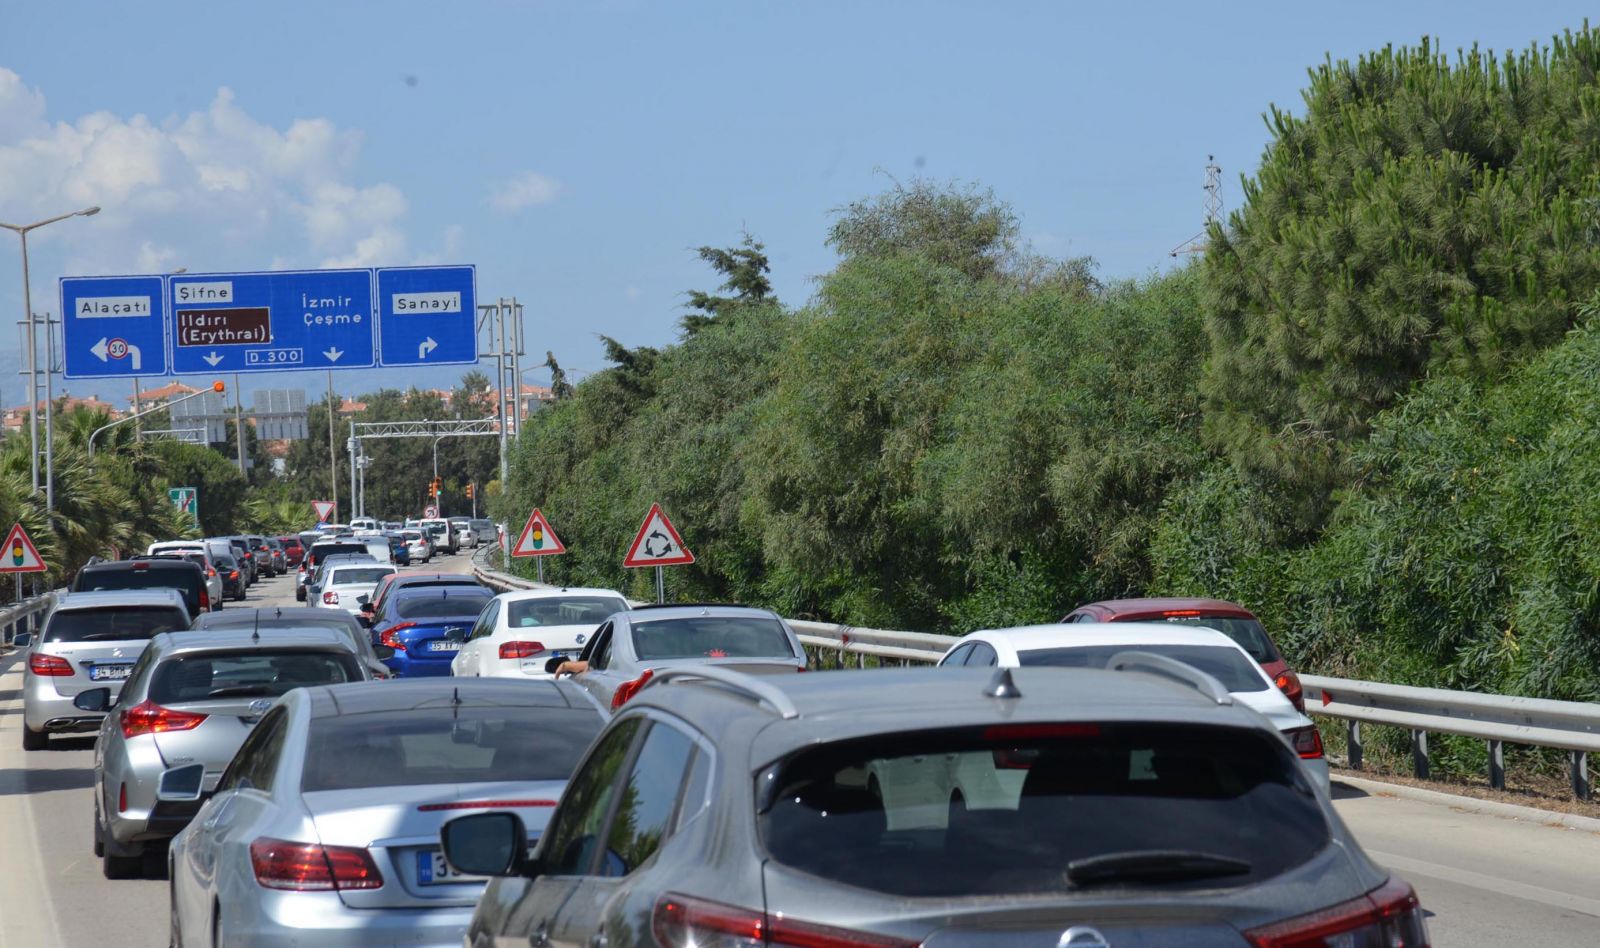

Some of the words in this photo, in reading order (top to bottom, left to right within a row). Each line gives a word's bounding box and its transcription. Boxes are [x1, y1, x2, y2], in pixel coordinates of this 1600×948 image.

[180, 287, 228, 300] Şifne
[302, 293, 352, 308] İzmir
[398, 297, 457, 311] Sanayi
[81, 302, 146, 314] Alaçatı
[303, 313, 362, 327] Çeşme
[182, 325, 266, 344] (Erythrai)
[111, 344, 125, 354] 30
[249, 351, 298, 362] D.300
